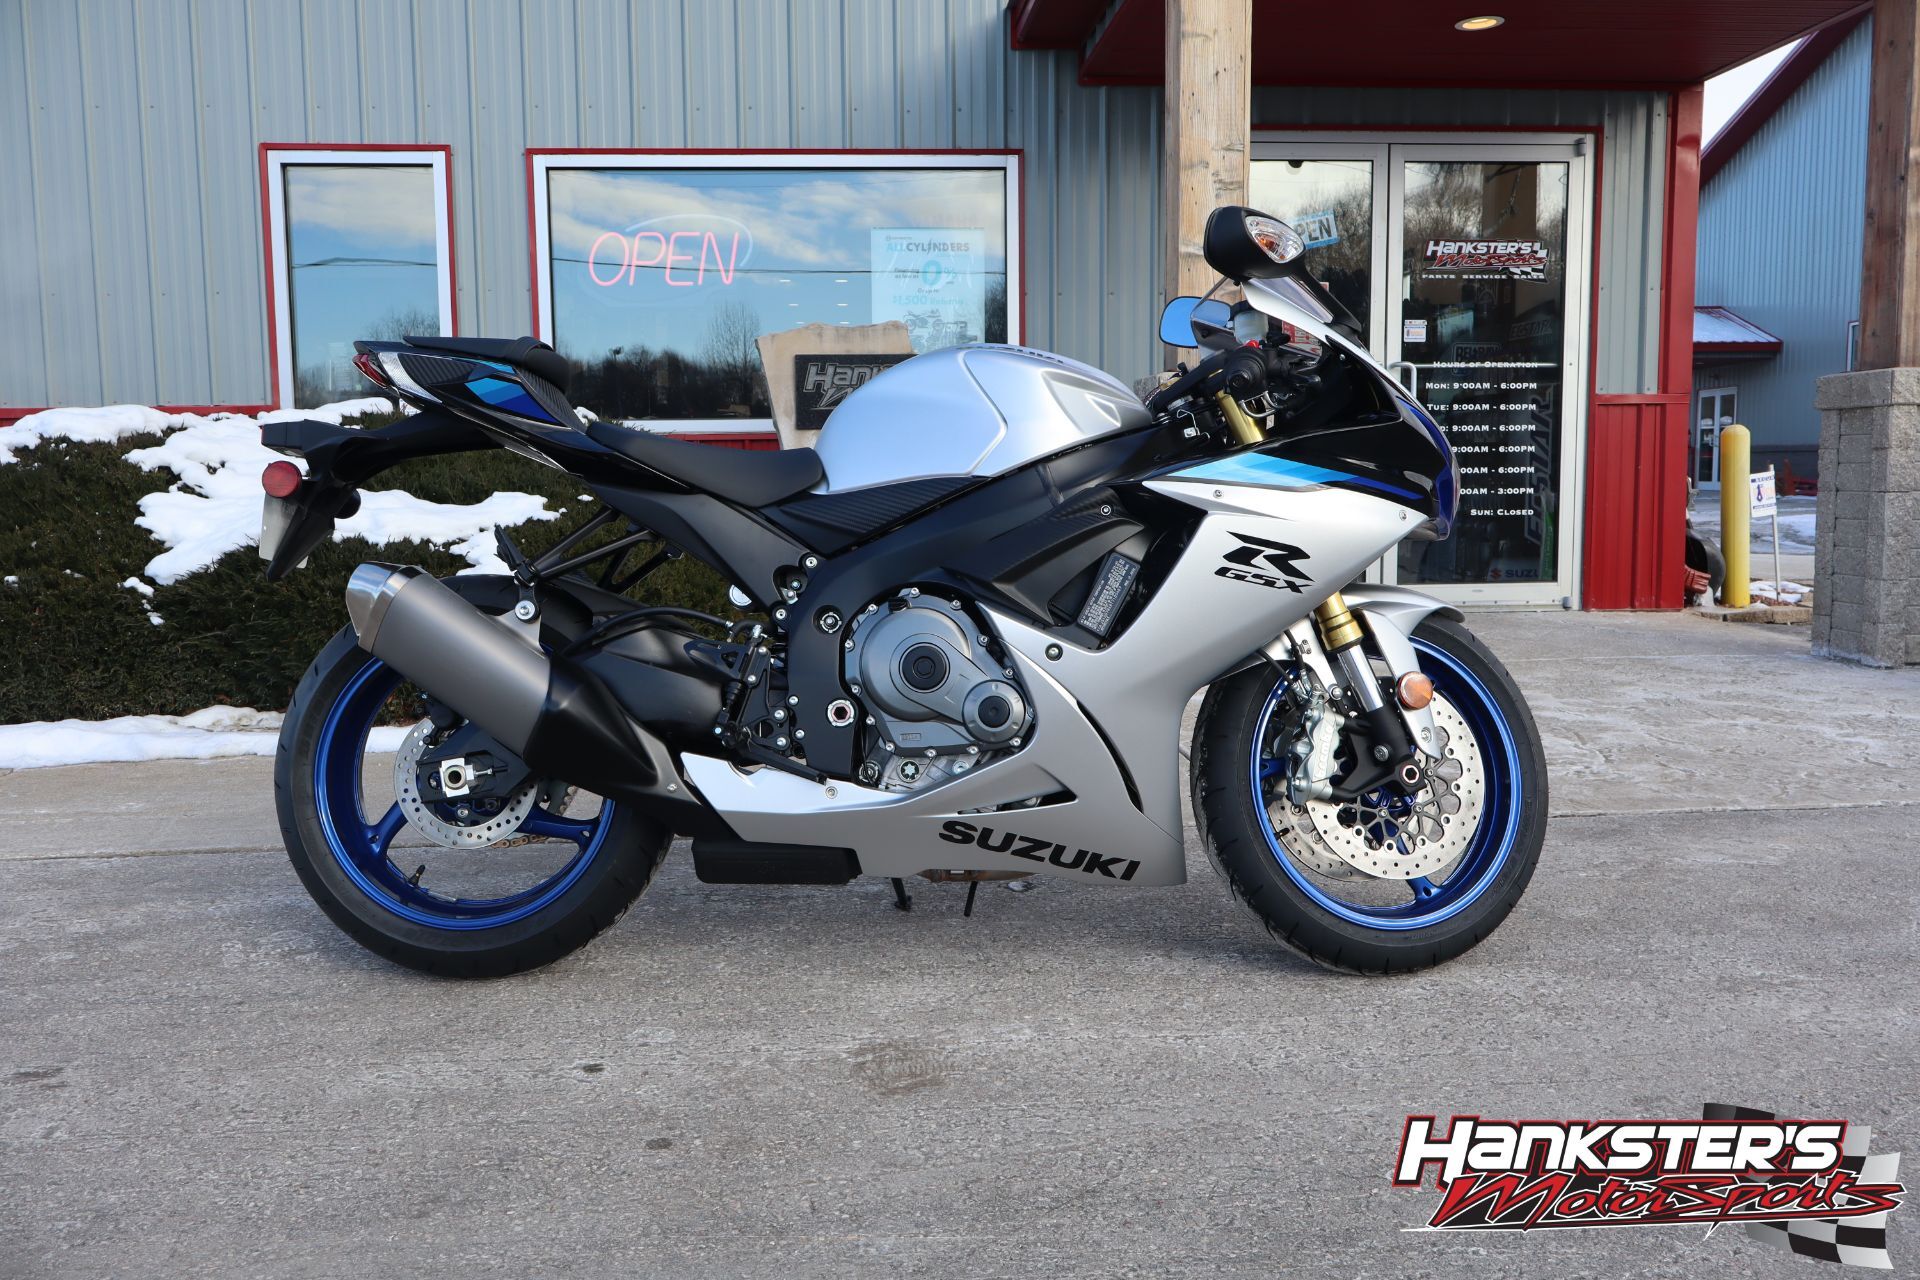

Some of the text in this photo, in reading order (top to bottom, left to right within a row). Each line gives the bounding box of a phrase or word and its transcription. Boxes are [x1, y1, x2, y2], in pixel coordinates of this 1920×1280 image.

[1294, 216, 1333, 242] PEN
[588, 231, 739, 287] OPEN
[1452, 403, 1490, 411] 9:00AM
[1499, 403, 1537, 411] 6:00PM
[1452, 424, 1489, 432] 9:00AM
[1451, 445, 1489, 453] 9:00AM
[1222, 530, 1316, 582] R
[1214, 566, 1313, 594] GSX
[1504, 569, 1539, 578] SUZ
[938, 820, 1141, 881] SUZUKI
